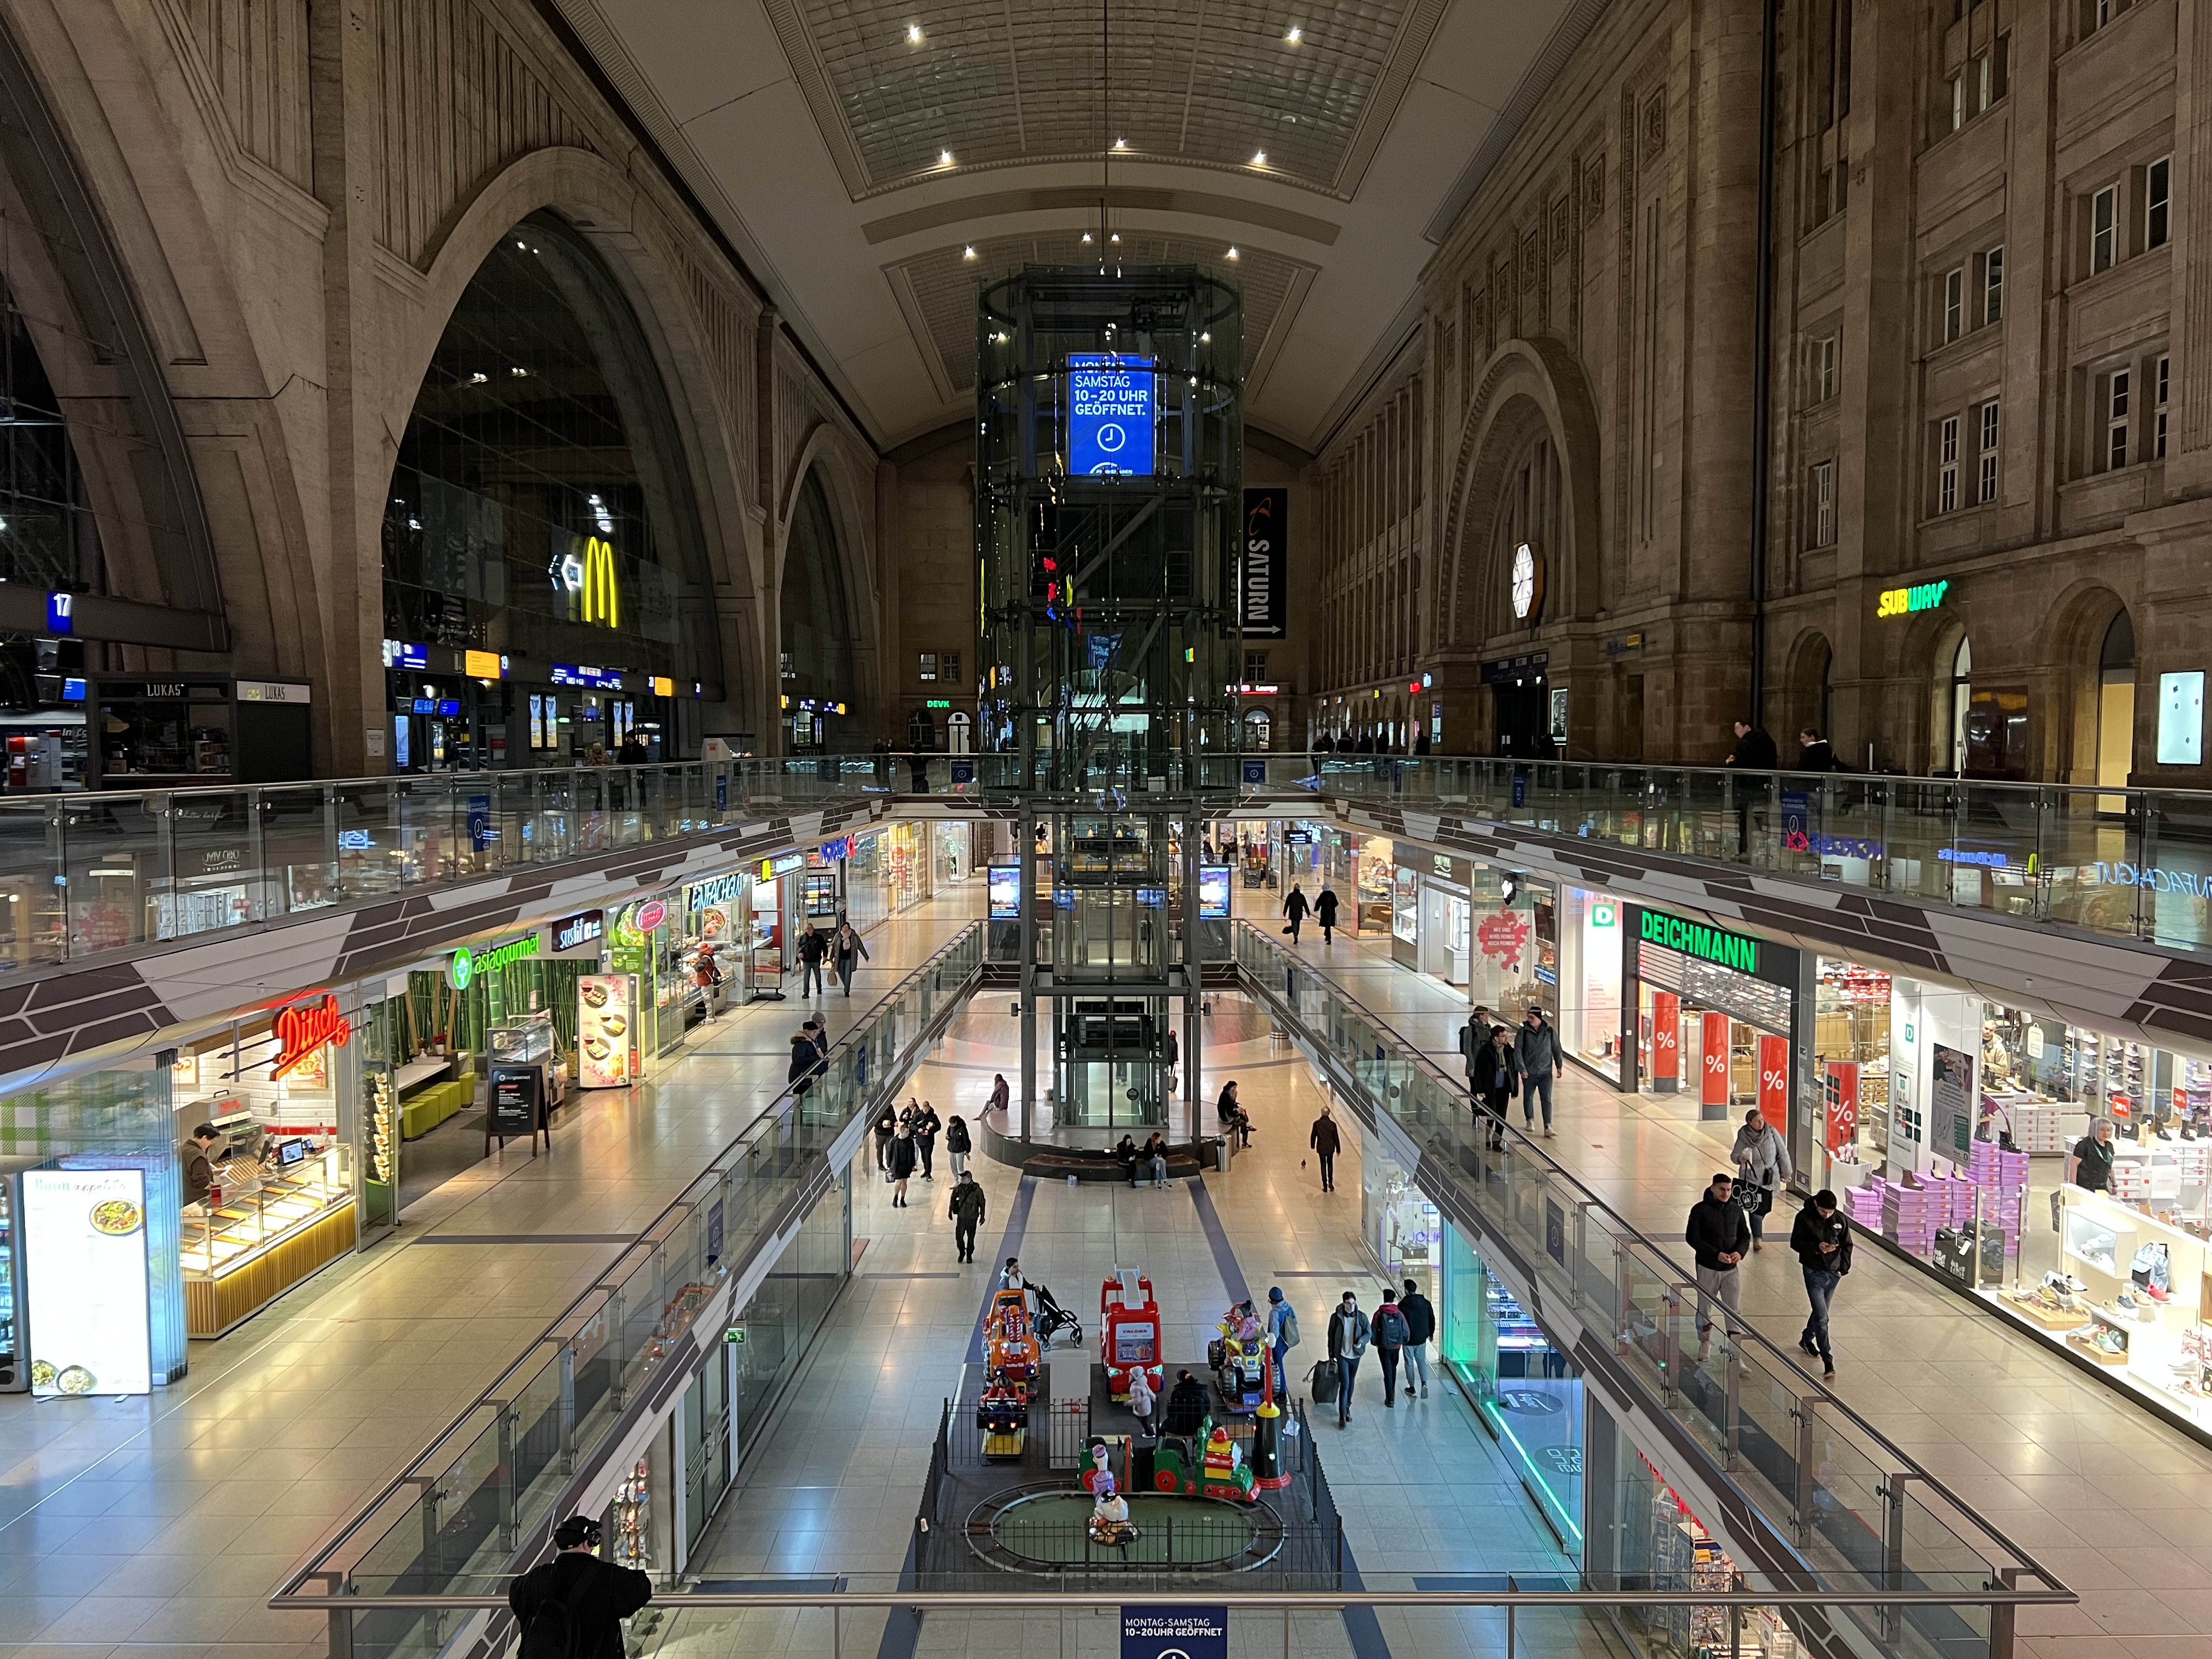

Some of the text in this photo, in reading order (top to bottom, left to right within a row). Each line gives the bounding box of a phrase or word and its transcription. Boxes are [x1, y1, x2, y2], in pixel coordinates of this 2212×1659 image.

[1075, 375, 1130, 387] SAMSTAG
[1119, 390, 1148, 401] UHR
[1075, 401, 1146, 415] GEÖFFNET.
[1248, 539, 1269, 620] SATURN
[54, 593, 72, 617] 17
[1877, 580, 1948, 618] SUBWAY
[147, 684, 180, 697] LUKAS
[264, 685, 285, 700] LUKAS
[1595, 907, 1613, 924] D
[1642, 911, 1754, 973] DEICHMANN
[475, 933, 540, 974] asiagourmet
[277, 994, 338, 1067] Ditsch
[2114, 1102, 2128, 1113] 30%
[1125, 1618, 1210, 1627] MONTAG-SAMSTAG
[1175, 1625, 1222, 1636] GEÖFFNET
